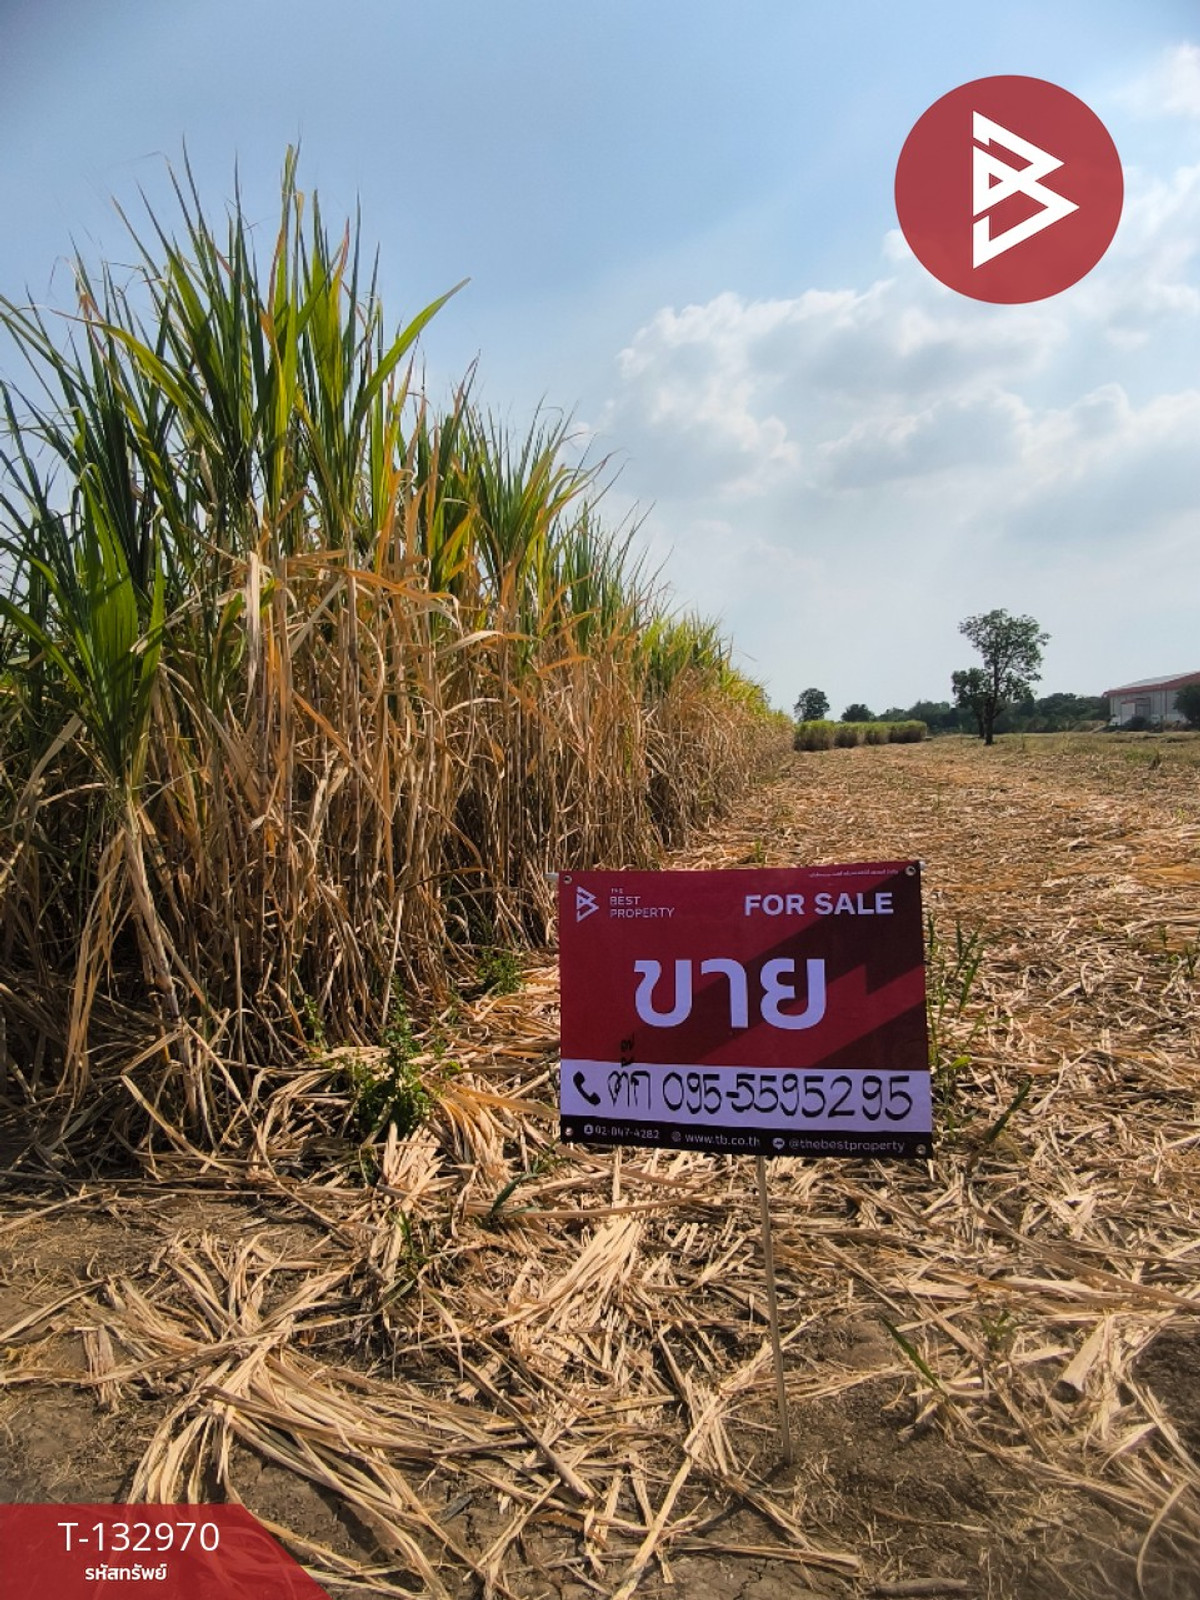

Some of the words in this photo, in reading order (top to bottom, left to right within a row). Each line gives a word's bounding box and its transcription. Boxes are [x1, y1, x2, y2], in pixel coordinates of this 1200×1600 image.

[610, 896, 642, 906] BEST
[744, 893, 805, 916] FOR
[814, 892, 894, 915] SALE
[610, 907, 676, 919] PROPERTY
[633, 957, 827, 1030] ขาย
[663, 1071, 914, 1121] 095-5595295
[685, 1133, 761, 1147] www.tb.co.th
[788, 1137, 906, 1153] @thebestproperty
